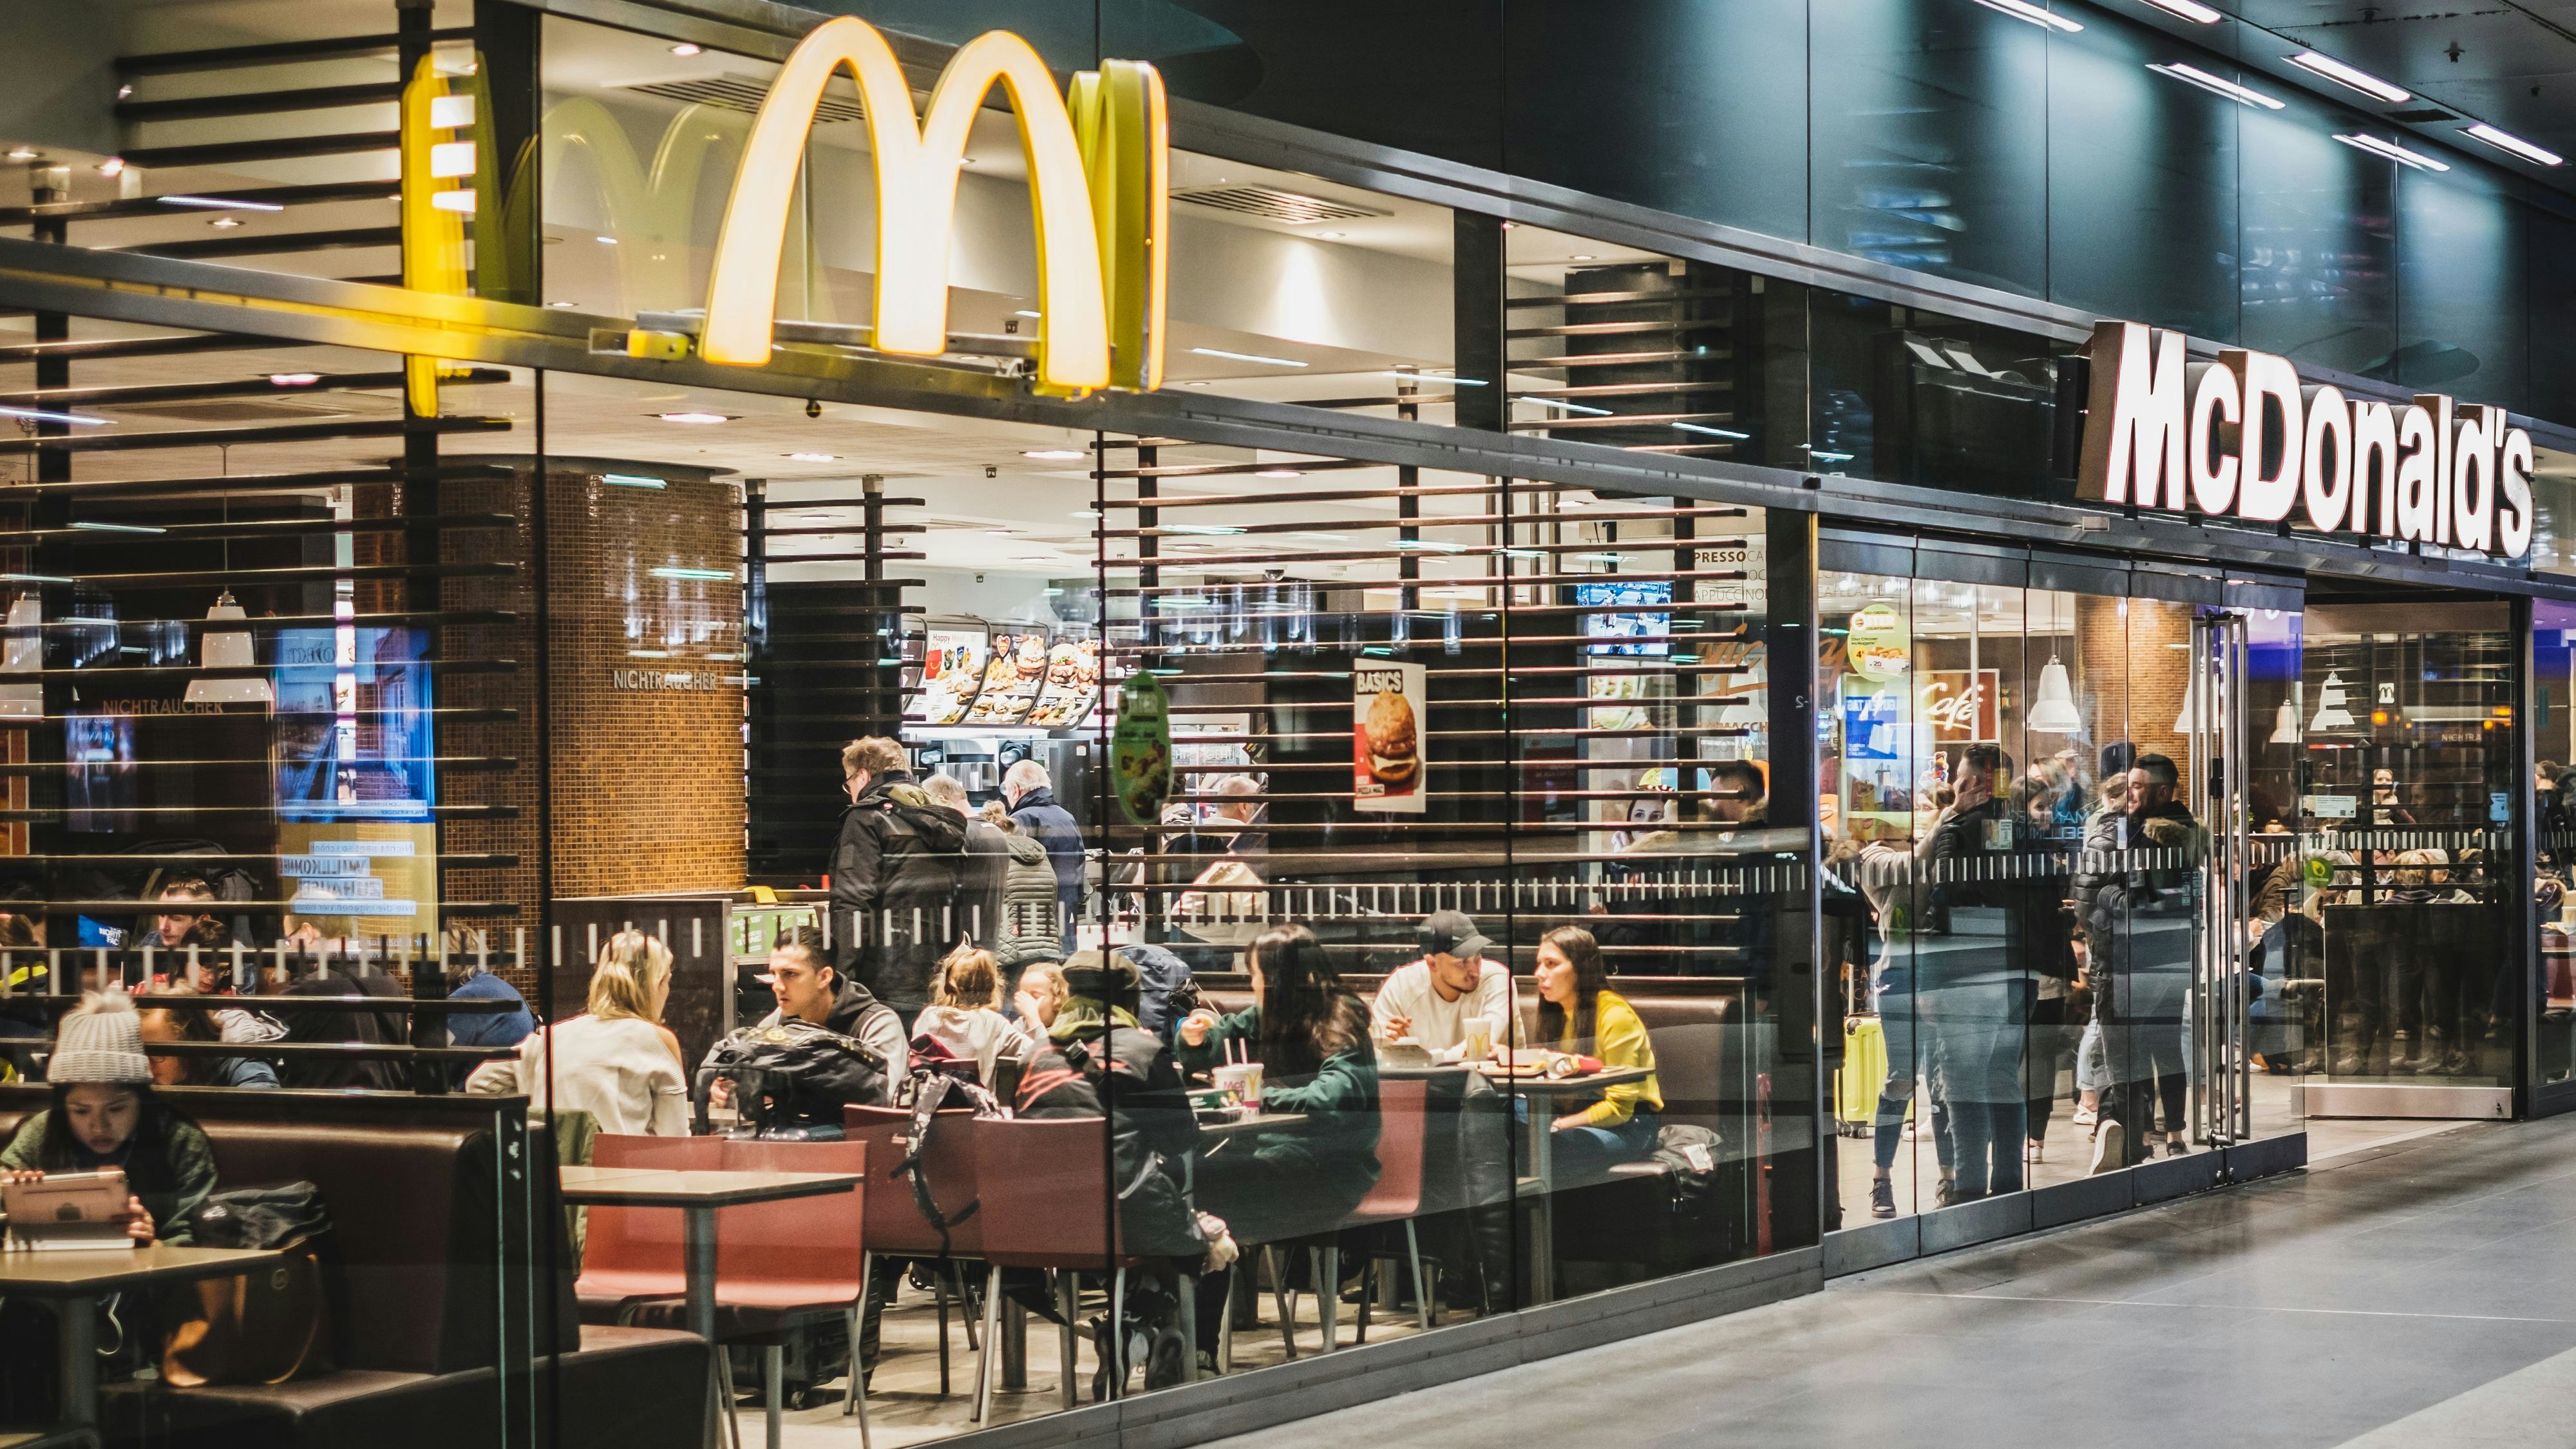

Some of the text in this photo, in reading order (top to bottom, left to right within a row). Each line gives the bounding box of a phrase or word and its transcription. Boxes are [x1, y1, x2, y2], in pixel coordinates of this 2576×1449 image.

[2103, 320, 2535, 559] McDonald's
[933, 634, 950, 643] Happy
[614, 670, 717, 690] NICHTRAUCHER
[1356, 671, 1402, 693] BASICS
[103, 699, 223, 714] NICHTRAUCHER
